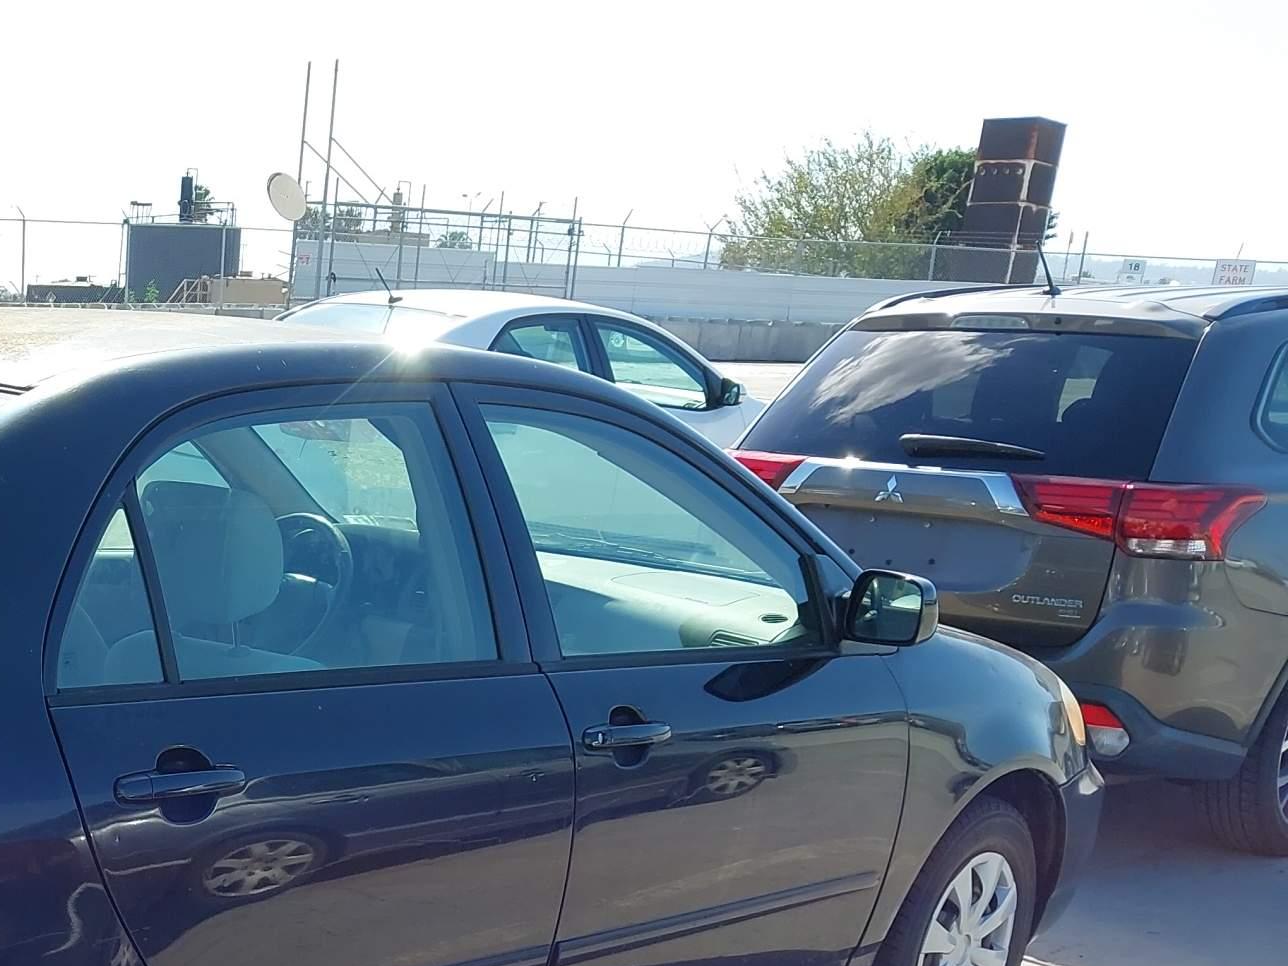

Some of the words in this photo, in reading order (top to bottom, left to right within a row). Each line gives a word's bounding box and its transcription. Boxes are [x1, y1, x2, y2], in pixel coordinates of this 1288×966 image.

[1220, 263, 1249, 273] STATE
[1218, 275, 1246, 285] FARM
[1012, 594, 1083, 608] OUTLANDER
